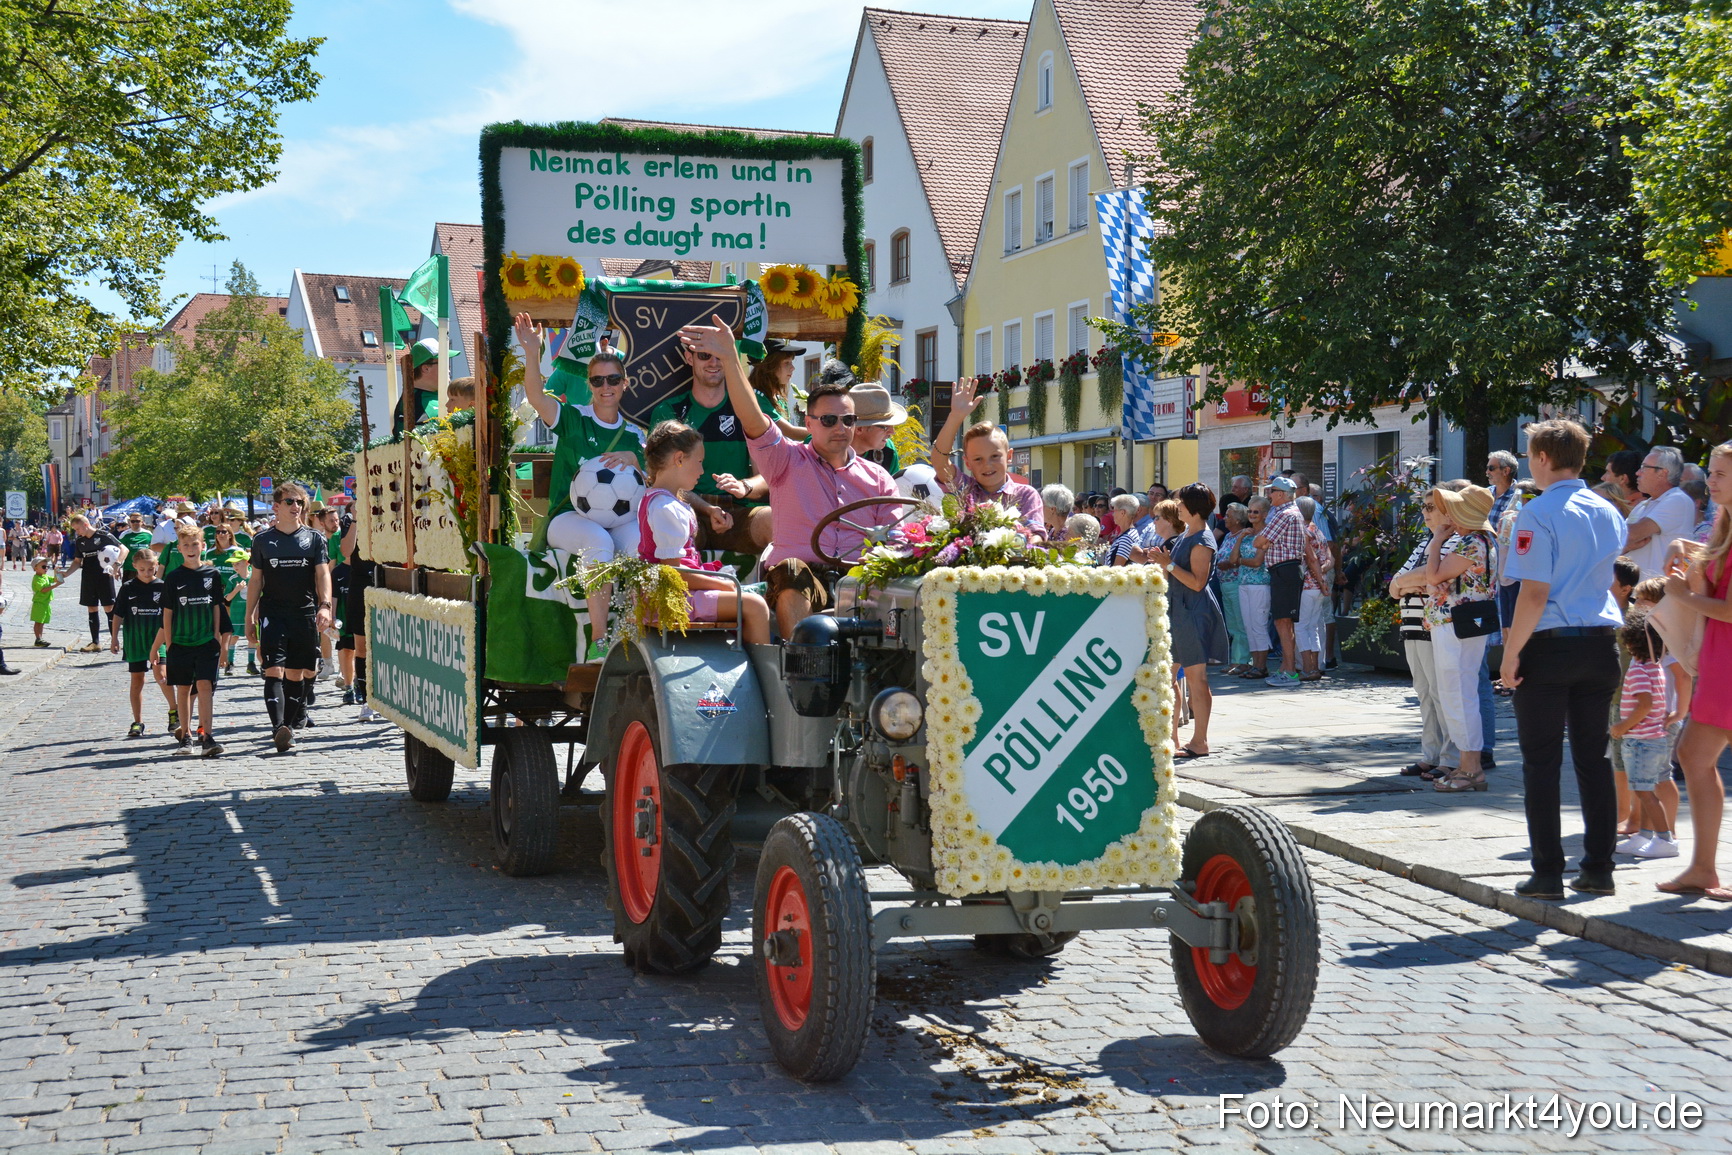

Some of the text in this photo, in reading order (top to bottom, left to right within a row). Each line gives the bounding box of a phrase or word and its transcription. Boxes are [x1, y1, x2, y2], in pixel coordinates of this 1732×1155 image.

[529, 148, 812, 183] Neimak erlem und in
[575, 183, 675, 221] Pölling
[567, 219, 616, 244] des
[624, 220, 703, 255] daugt
[577, 319, 590, 329] SV
[635, 306, 668, 330] SV
[577, 345, 592, 353] 1950
[627, 342, 689, 398] PÖLLI
[1162, 402, 1175, 414] KINO
[1185, 379, 1194, 434] KINO
[375, 608, 466, 674] SOMOS LOS VERDES
[978, 610, 1045, 657] SV
[377, 660, 466, 740] MIA SAN DE GREANA
[982, 637, 1123, 795] PÖLLING
[1056, 753, 1128, 833] 1950
